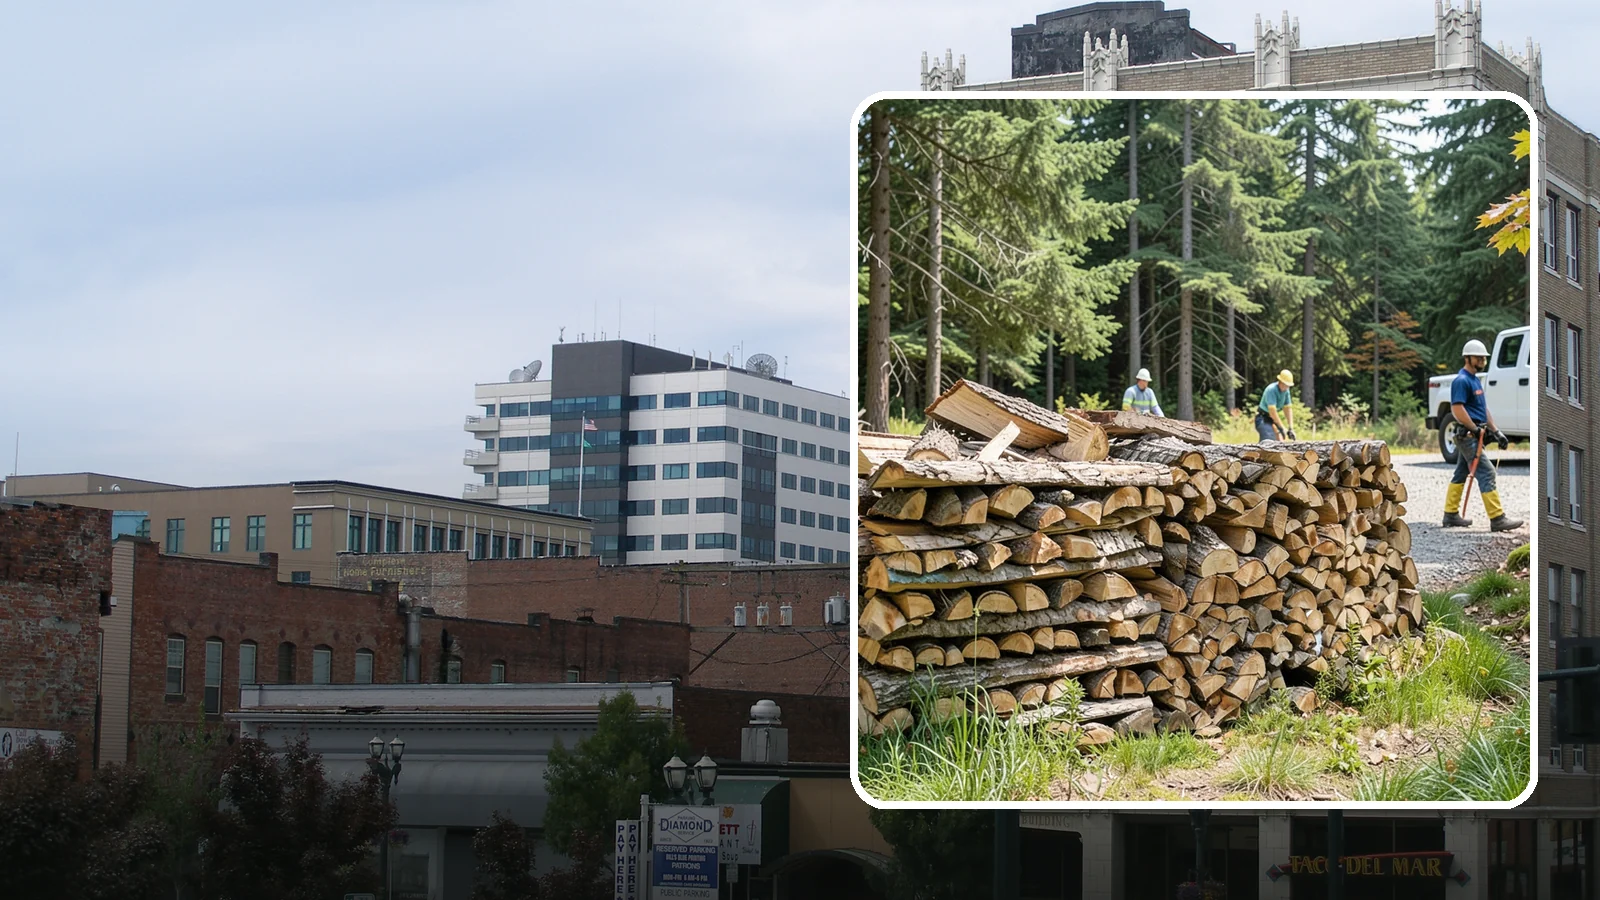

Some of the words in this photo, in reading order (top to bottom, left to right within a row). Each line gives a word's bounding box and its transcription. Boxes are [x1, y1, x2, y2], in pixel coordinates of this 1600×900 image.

[343, 568, 368, 577] Home
[370, 566, 427, 577] Furnishers
[660, 818, 713, 832] DIAMOND
[1022, 815, 1070, 828] BUILDING
[719, 823, 740, 835] ETT
[617, 824, 625, 852] PAY
[628, 824, 637, 852] PAY
[656, 845, 688, 853] RESERVED
[689, 846, 716, 854] PARKING
[627, 855, 636, 893] HERE
[1346, 857, 1385, 876] DEL
[1392, 857, 1442, 877] MAR
[616, 856, 625, 894] HERE
[660, 889, 682, 897] PUBLIC
[683, 890, 710, 898] PARKING
